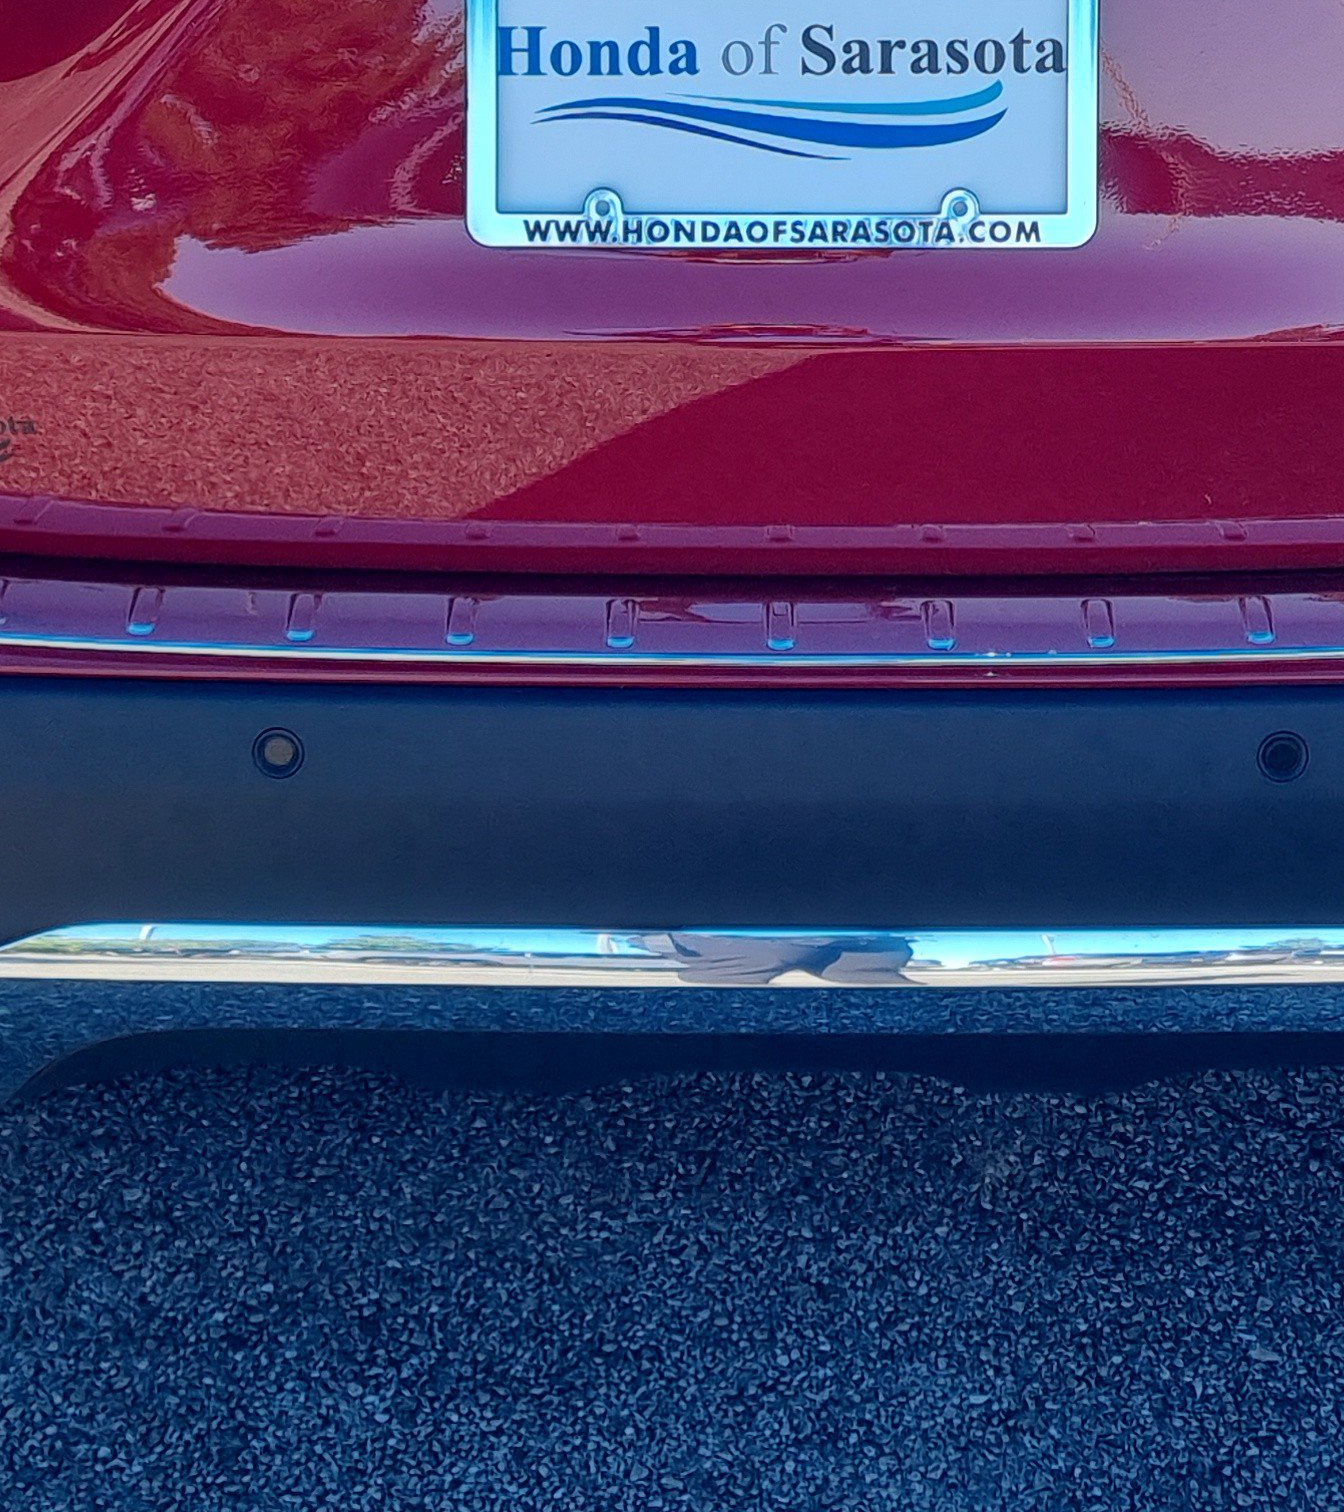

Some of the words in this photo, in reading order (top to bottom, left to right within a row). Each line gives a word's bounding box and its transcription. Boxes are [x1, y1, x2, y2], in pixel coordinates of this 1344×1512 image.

[497, 26, 699, 77] Honda
[720, 23, 788, 76] of
[800, 24, 1068, 76] Sarasota
[523, 219, 1042, 244] WWW.HONDAOFSARASOTA.COM
